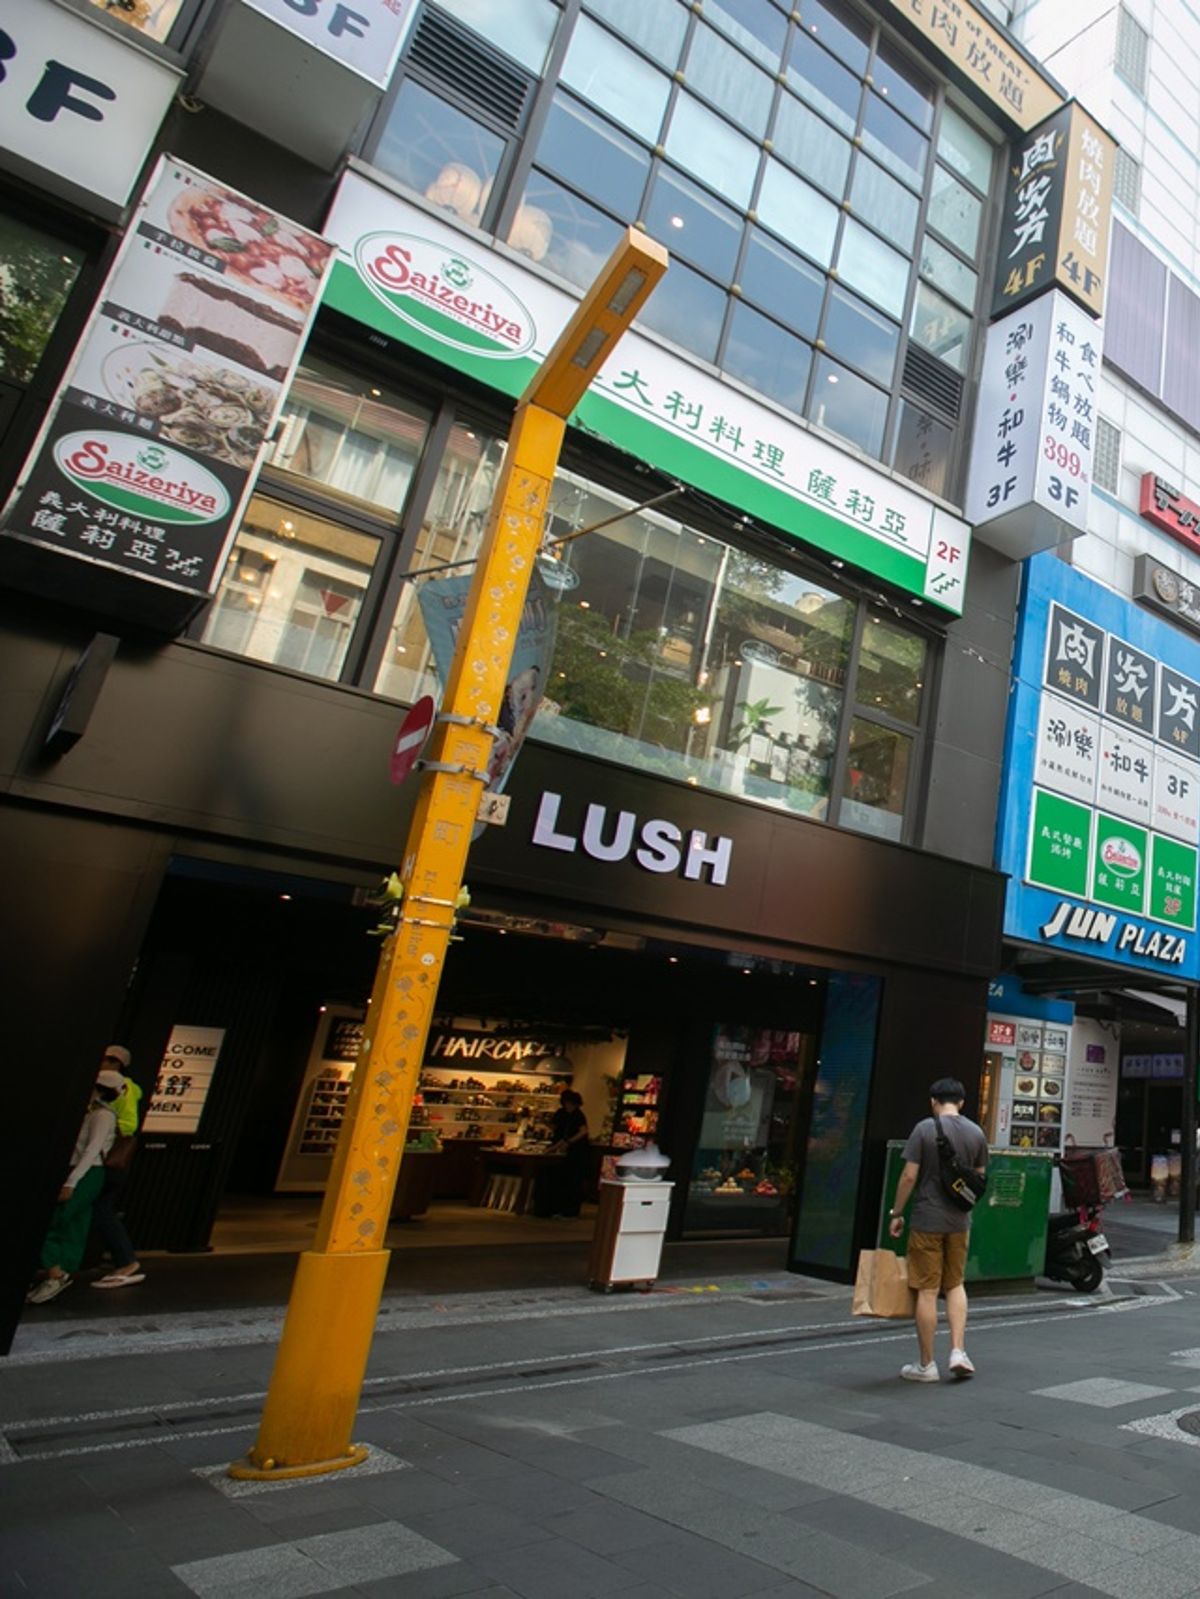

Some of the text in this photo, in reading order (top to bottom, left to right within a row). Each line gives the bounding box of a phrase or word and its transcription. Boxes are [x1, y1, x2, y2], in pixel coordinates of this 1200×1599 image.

[0, 28, 117, 122] F
[911, 0, 1023, 114] 肉放題
[367, 244, 522, 342] Saizeriya
[1003, 252, 1047, 297] 4F
[1061, 251, 1101, 298] 4F
[1047, 322, 1075, 432] 和牛鍋物
[1071, 342, 1097, 450] 食べ放題
[65, 441, 217, 510] Saizeriya
[591, 369, 909, 542] 大利料理 薩莉亞
[40, 491, 167, 543] 義大利料理
[986, 475, 1018, 508] 3F
[1047, 475, 1079, 509] 3F
[31, 509, 157, 565] 薩莉亞
[937, 541, 960, 563] 2F
[1167, 776, 1189, 798] 3F
[532, 791, 733, 886] LUSH
[1041, 902, 1187, 964] JUN PLAZA
[165, 1044, 218, 1056] COME
